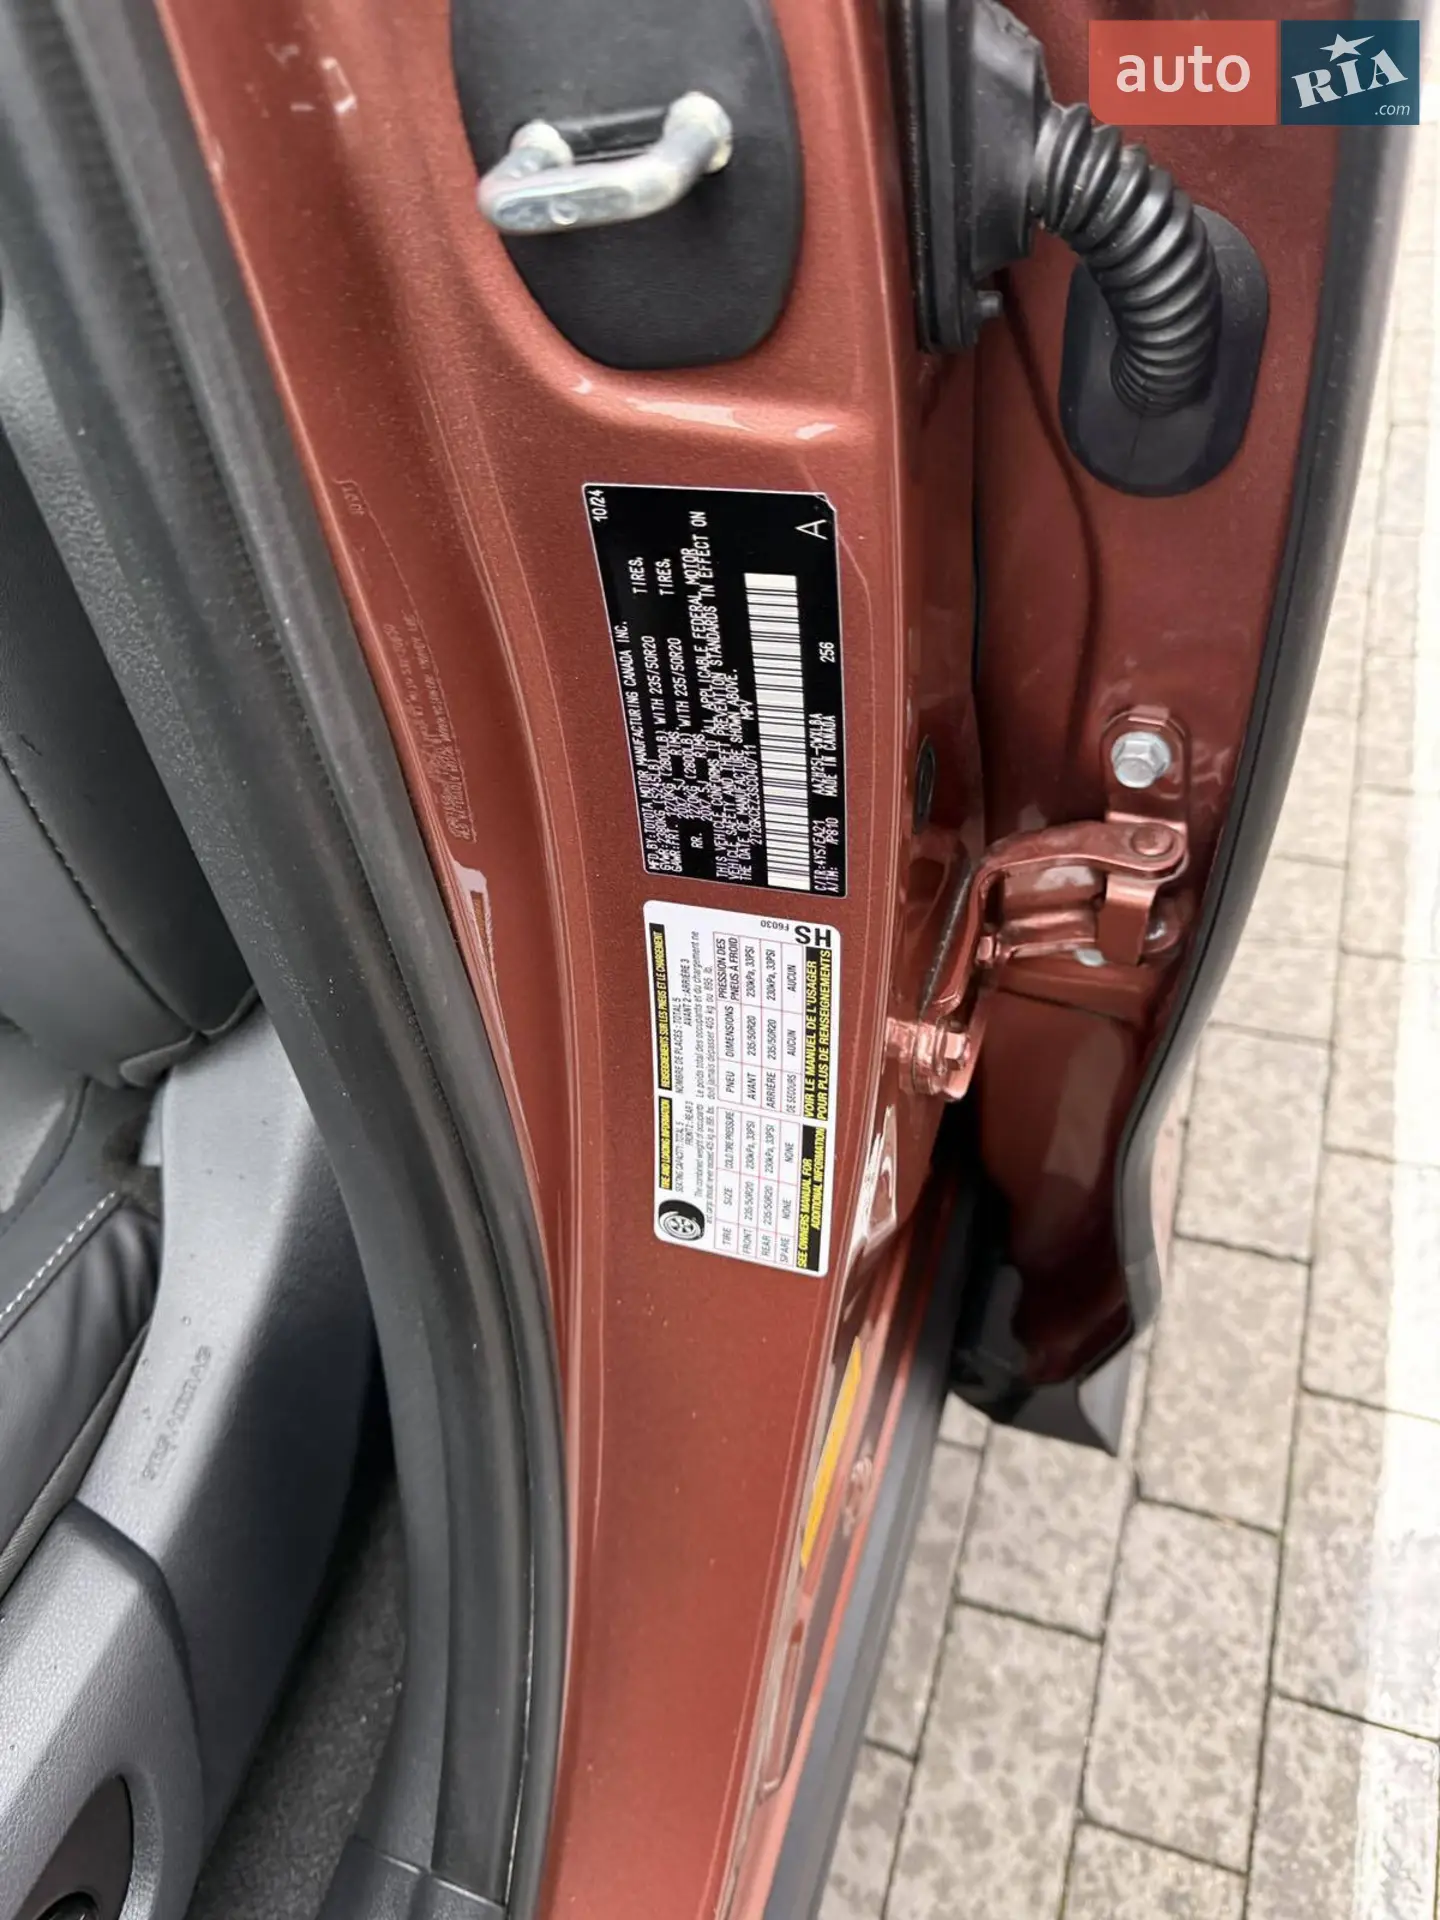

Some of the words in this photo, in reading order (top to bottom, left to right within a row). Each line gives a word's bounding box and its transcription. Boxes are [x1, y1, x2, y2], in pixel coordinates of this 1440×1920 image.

[588, 489, 608, 522] 10/24
[689, 511, 707, 527] ON
[794, 519, 828, 540] A
[680, 548, 700, 584] MOTOR
[693, 534, 714, 578] EFFECT
[628, 557, 648, 594] TIRES,
[655, 558, 675, 595] TIRES,
[700, 584, 716, 597] IN
[687, 592, 707, 639] FEDERAL
[614, 621, 630, 643] INC.
[703, 605, 723, 666] STANDARDS
[641, 636, 663, 695] 235/50R20
[818, 641, 835, 663] 256
[619, 650, 637, 686] CANADA
[667, 638, 689, 697] 235/50R20
[693, 644, 716, 710] APPLICABLE
[725, 669, 740, 706] ABOVE.
[650, 698, 666, 725] WITH
[676, 701, 692, 727] WITH
[711, 672, 731, 736] PREVENTION
[740, 699, 754, 720] MPV
[625, 691, 649, 766] MANUFACTURING
[702, 716, 717, 735] ALL
[728, 711, 743, 743] SHOWN
[820, 715, 837, 751] CANADA
[655, 730, 673, 777] (2800LB)
[668, 727, 682, 756] RIMS.
[705, 740, 719, 752] TO
[680, 732, 697, 779] (2800LB)
[718, 741, 733, 771] THEFT
[822, 756, 837, 767] IN
[637, 770, 653, 798] MOTOR
[707, 758, 723, 806] CONFORMS
[721, 777, 734, 796] AND
[731, 749, 748, 815] MANUFACTURE
[823, 774, 838, 797] MADE
[662, 783, 677, 816] 1270KG
[687, 785, 702, 819] 1270KG
[709, 812, 727, 851] VEHICLE
[722, 801, 738, 836] SAFETY
[736, 821, 749, 832] OF
[691, 833, 704, 849] RR.
[737, 838, 751, 859] DATE
[715, 856, 728, 877] THIS
[726, 842, 741, 880] VEHICLE
[740, 865, 752, 881] THE
[690, 931, 699, 941] ne
[760, 920, 790, 931] F6030
[653, 931, 665, 972] CHARGEMENT
[716, 938, 726, 956] DES
[728, 937, 738, 964] FROID
[745, 945, 755, 967] 33PSI
[766, 948, 776, 970] 33PSI
[691, 941, 703, 984] chargement
[726, 964, 739, 972] À
[655, 972, 666, 981] LE
[656, 981, 666, 990] ET
[692, 984, 702, 994] du
[716, 957, 727, 999] PRESSION
[729, 973, 739, 1001] PNEUS
[787, 964, 797, 992] AUCUN
[806, 960, 818, 1013] L'USAGER
[656, 990, 667, 1010] PNEUS
[818, 949, 832, 1045] RENSEIGNEMENTS
[657, 1010, 668, 1022] LES
[672, 1003, 682, 1024] TOTAL
[682, 1003, 692, 1027] AVANT
[805, 1016, 817, 1030] DE
[658, 1022, 669, 1035] SUR
[672, 1029, 683, 1055] PLACES
[724, 1006, 735, 1057] DIMENSIONS
[746, 1015, 757, 1057] 235/50R20
[767, 1019, 777, 1060] 235/50R20
[787, 1029, 797, 1057] AUCUN
[805, 1032, 817, 1076] MANUEL
[817, 1047, 830, 1061] DE
[673, 1056, 684, 1065] DE
[694, 1053, 704, 1069] total
[674, 1066, 684, 1094] NOMBRE
[725, 1071, 735, 1093] PNEU
[747, 1072, 757, 1100] AVANT
[804, 1077, 816, 1091] LE
[816, 1063, 829, 1090] PLUS
[787, 1104, 796, 1113] DE
[804, 1093, 815, 1118] VOIR
[816, 1091, 828, 1120] POUR
[784, 1142, 794, 1163] NONE
[813, 1127, 826, 1183] INFORMATION
[802, 1158, 812, 1176] FOR
[723, 1187, 733, 1206] SIZE
[762, 1185, 773, 1225] 235/50R20
[781, 1198, 792, 1220] NONE
[801, 1178, 812, 1213] MANUAL
[810, 1183, 823, 1229] ADDITIONAL
[722, 1227, 732, 1245] TIRE
[742, 1229, 752, 1255] FRONT
[761, 1234, 771, 1257] REAR
[799, 1214, 810, 1250] OWNERS
[779, 1237, 790, 1263] SPARE
[798, 1251, 808, 1267] SEE
